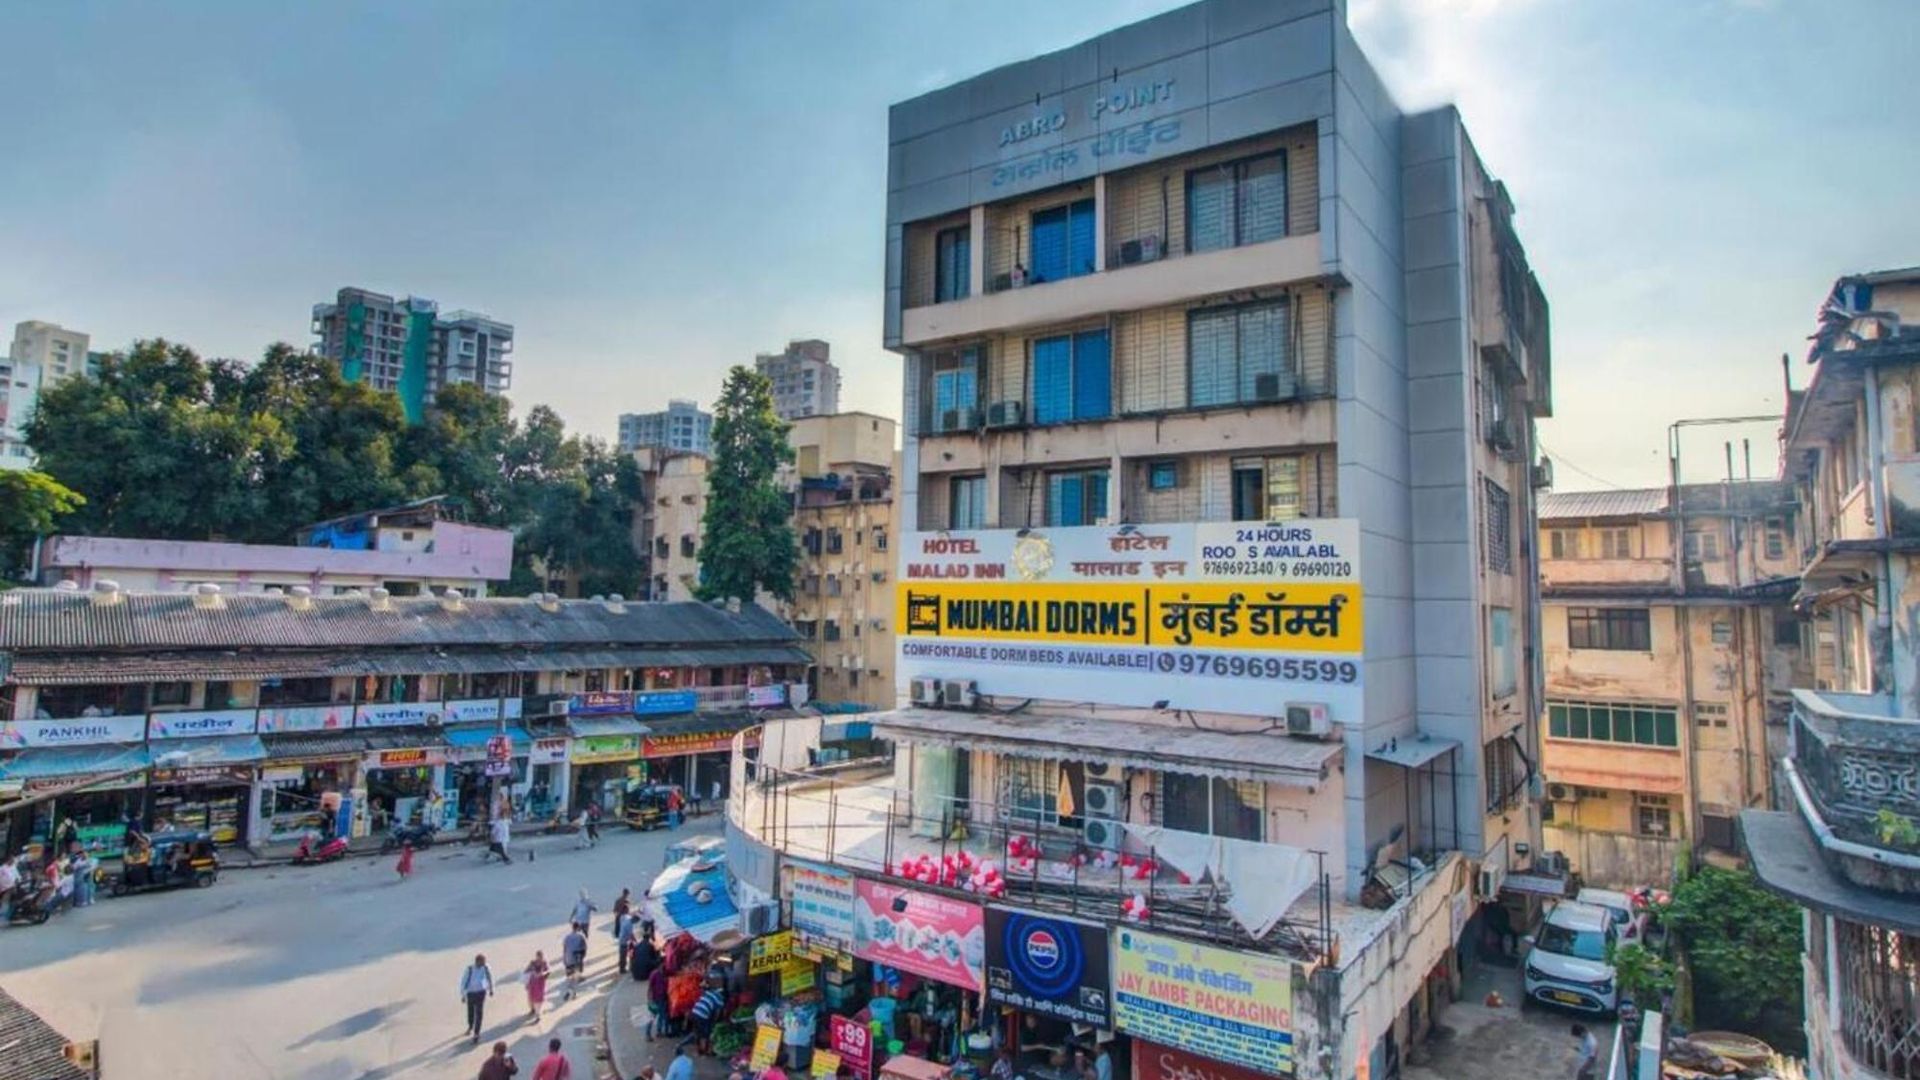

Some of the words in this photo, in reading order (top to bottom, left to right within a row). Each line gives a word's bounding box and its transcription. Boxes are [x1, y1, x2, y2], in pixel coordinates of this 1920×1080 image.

[999, 112, 1066, 148] ABRO
[1091, 80, 1175, 120] POINT
[1236, 530, 1253, 542] 24
[1257, 529, 1312, 542] HOURS
[924, 539, 980, 554] HOTEL
[1264, 545, 1340, 558] AVAILABL
[908, 564, 969, 578] MALAD
[974, 564, 1005, 578] INN
[1150, 561, 1188, 578] इन
[947, 600, 1039, 631] MUMBAI
[1046, 601, 1136, 636] DORMS
[1160, 593, 1246, 645] मुंबई
[903, 644, 987, 660] COMFORTABLE
[991, 648, 1029, 661] DORM
[1030, 649, 1064, 662] BEDS
[1180, 653, 1357, 683] 9769695599
[38, 725, 111, 738] PANKHIL
[752, 953, 788, 969] XEROX
[1118, 971, 1143, 992] JAY
[1148, 978, 1190, 1005] AMBE
[1196, 990, 1290, 1028] PACKAGING
